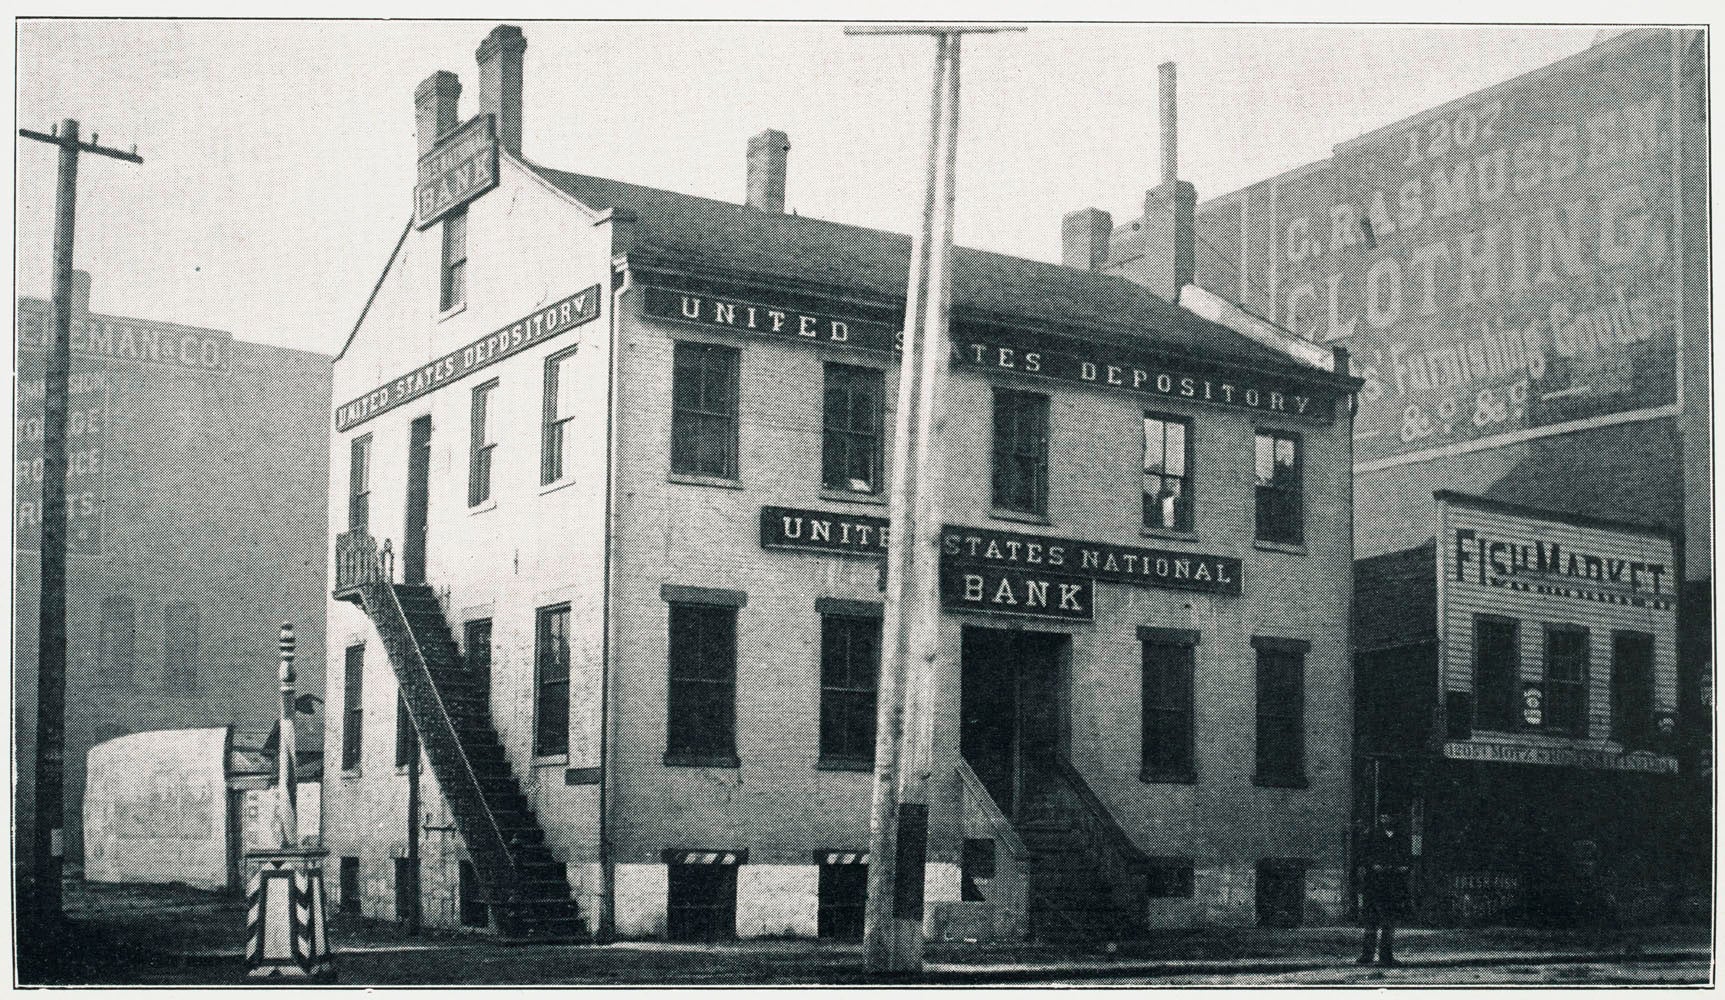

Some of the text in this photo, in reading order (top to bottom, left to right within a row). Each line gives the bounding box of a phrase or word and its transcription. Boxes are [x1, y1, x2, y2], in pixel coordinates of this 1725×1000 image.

[1405, 101, 1502, 166] 1207
[421, 152, 491, 217] BANK
[180, 335, 228, 368] CO.
[337, 294, 586, 425] UNITED STATES DEPOSITORY
[681, 297, 848, 341] UNITED
[1081, 361, 1309, 414] DEPOSITORY
[1391, 319, 1545, 396] Furnishing
[1550, 286, 1655, 357] Goods
[783, 515, 1231, 584] UNITE STATES NATIONAL
[964, 574, 1081, 612] BANK
